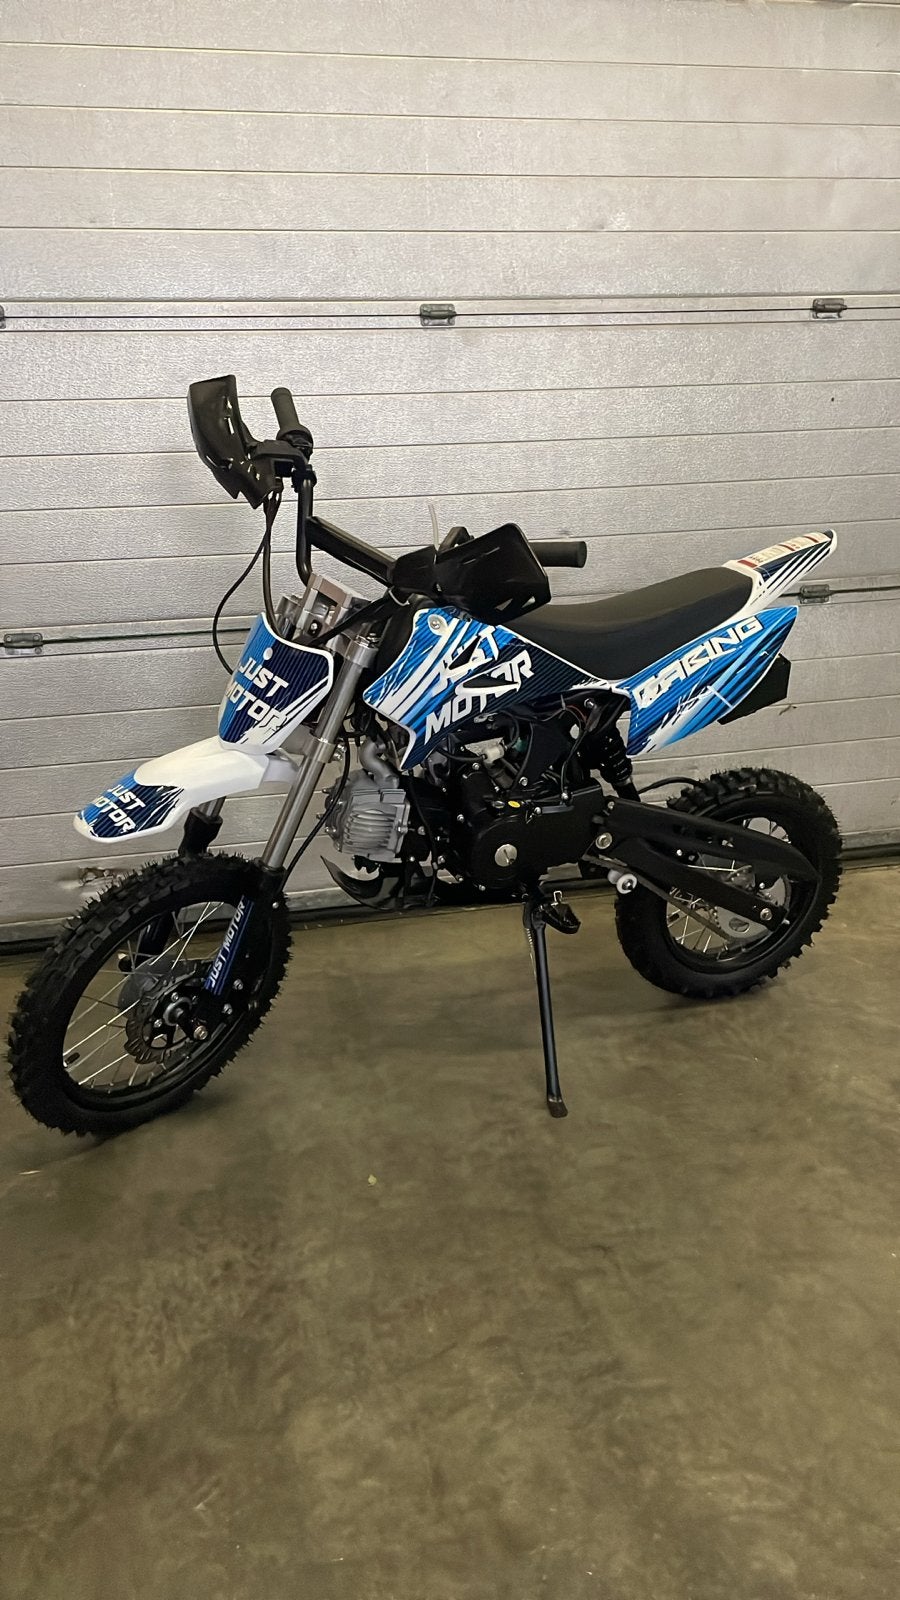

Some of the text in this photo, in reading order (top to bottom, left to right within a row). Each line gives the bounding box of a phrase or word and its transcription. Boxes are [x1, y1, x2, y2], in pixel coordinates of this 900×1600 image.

[239, 657, 289, 697] JUST
[107, 784, 146, 810] JUST
[210, 899, 246, 988] JUST MOTOR
